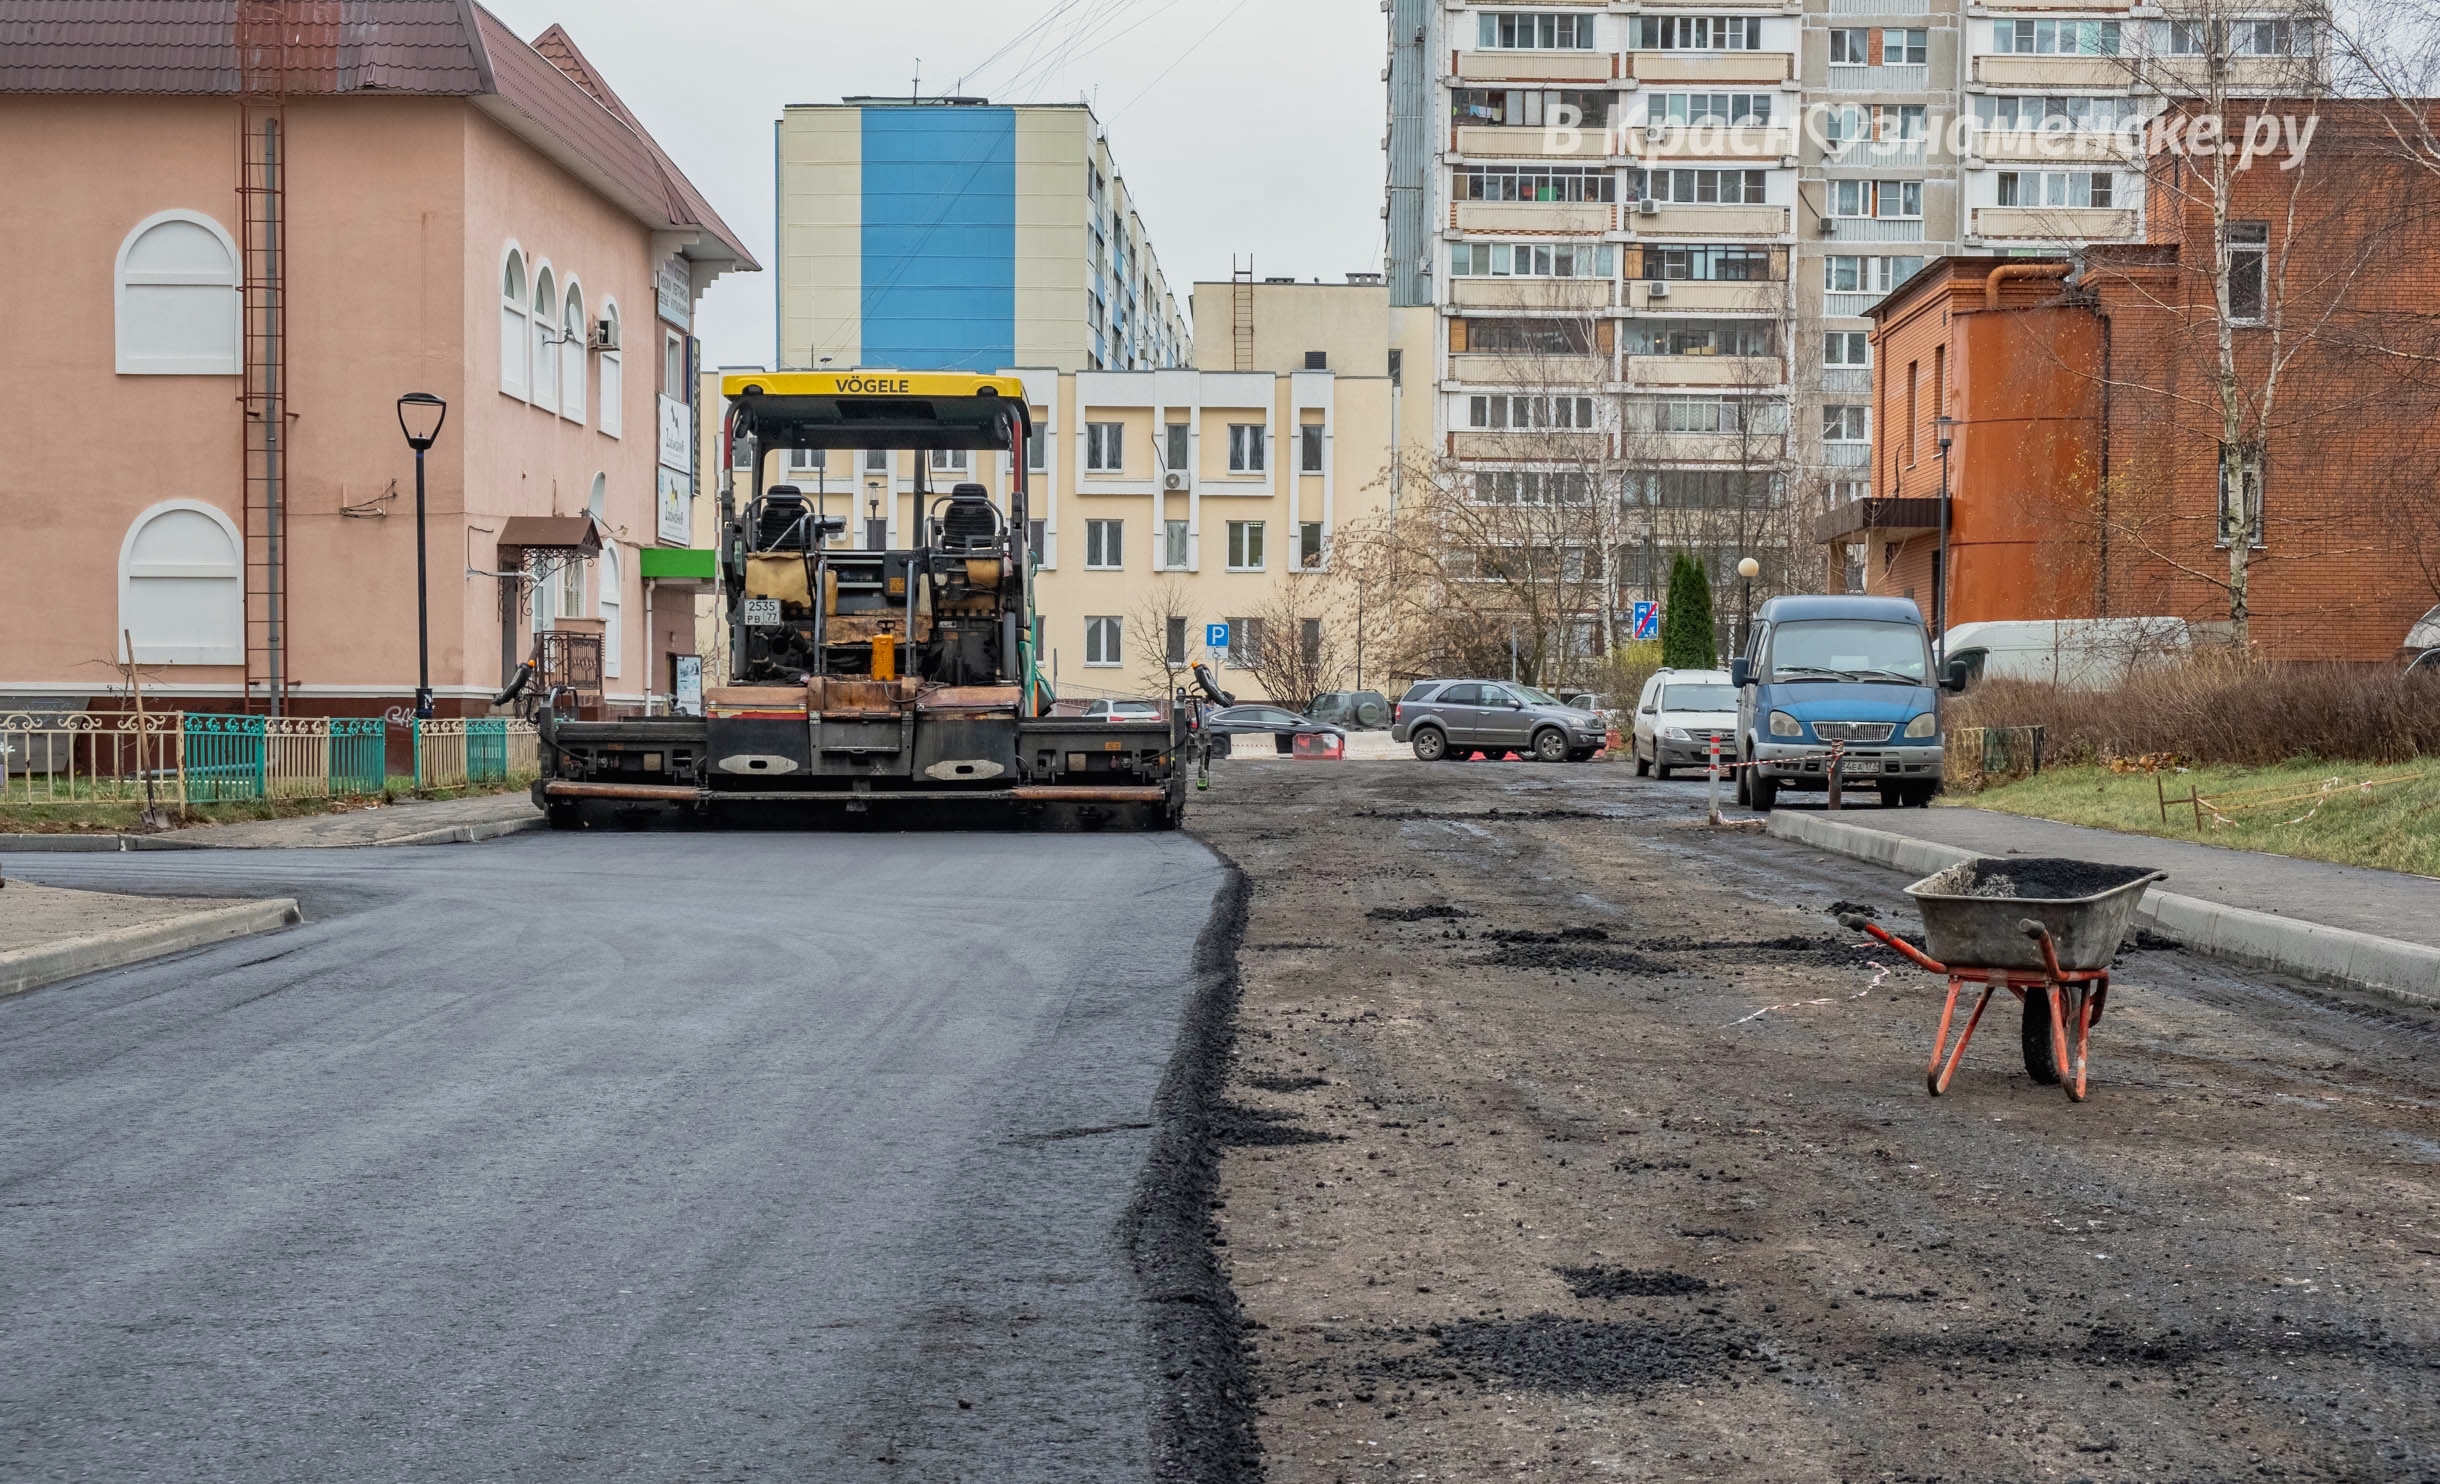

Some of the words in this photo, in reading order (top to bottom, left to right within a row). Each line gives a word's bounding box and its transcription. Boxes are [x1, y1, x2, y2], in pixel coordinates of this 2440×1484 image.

[835, 375, 909, 393] VÖGELE
[748, 601, 776, 612] 2535
[766, 613, 777, 622] 77
[1212, 626, 1225, 645] P
